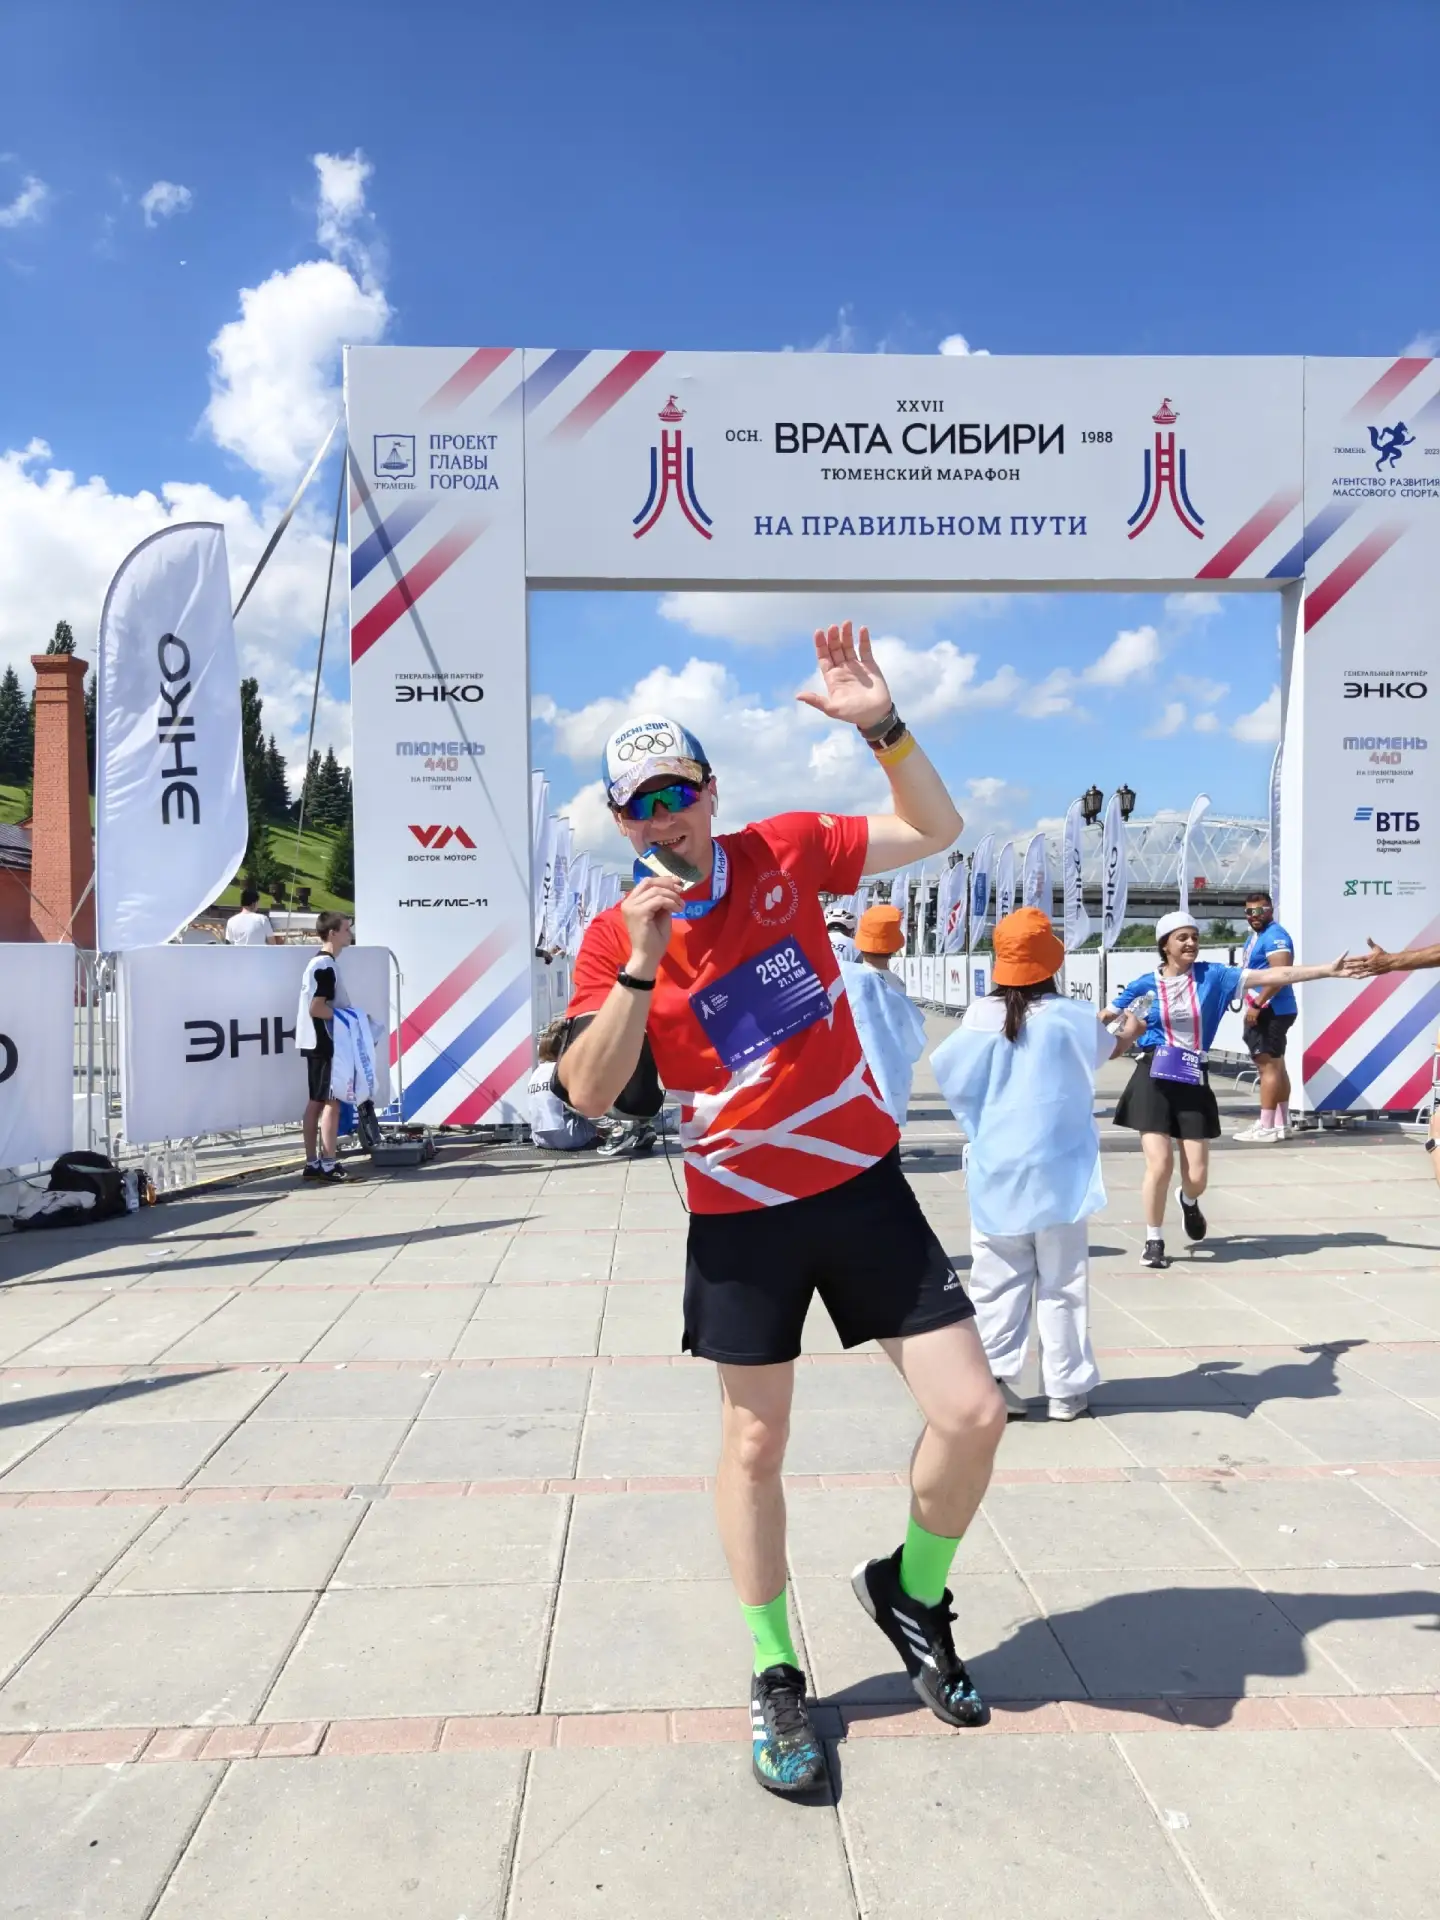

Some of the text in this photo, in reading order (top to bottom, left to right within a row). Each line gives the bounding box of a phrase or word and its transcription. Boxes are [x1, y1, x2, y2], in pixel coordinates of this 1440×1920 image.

[896, 400, 944, 412] XXVII
[430, 434, 498, 450] ПРОЕКТ
[725, 422, 1113, 455] ОСН. ВРАТА СИБИРИ 1988
[430, 455, 488, 470] ГЛАВЫ
[821, 466, 1020, 481] ТЮМЕНСКИЙ МАРАФОН
[430, 474, 499, 491] ГОРОДА
[1332, 477, 1440, 487] АГЕНТСТВО РАЗВИТИЯ
[1332, 488, 1440, 498] МАССОВОГО СПОРТА
[754, 515, 1087, 536] НА ПРАВИЛЬНОМ ПУТИ
[395, 672, 449, 680] ГЕНЕРАЛЬНЫЙ
[395, 685, 484, 702] ЭНКО
[1343, 682, 1428, 699] ЭНКО
[158, 632, 200, 825] ЭНКО
[644, 722, 669, 731] 2014
[424, 757, 459, 771] 440
[1369, 751, 1402, 765] 440
[1376, 811, 1420, 832] ВТБ
[1376, 838, 1421, 847] Официальный
[755, 947, 801, 985] 2592
[777, 973, 794, 988] 21.1
[1070, 982, 1093, 1002] ЭНКО
